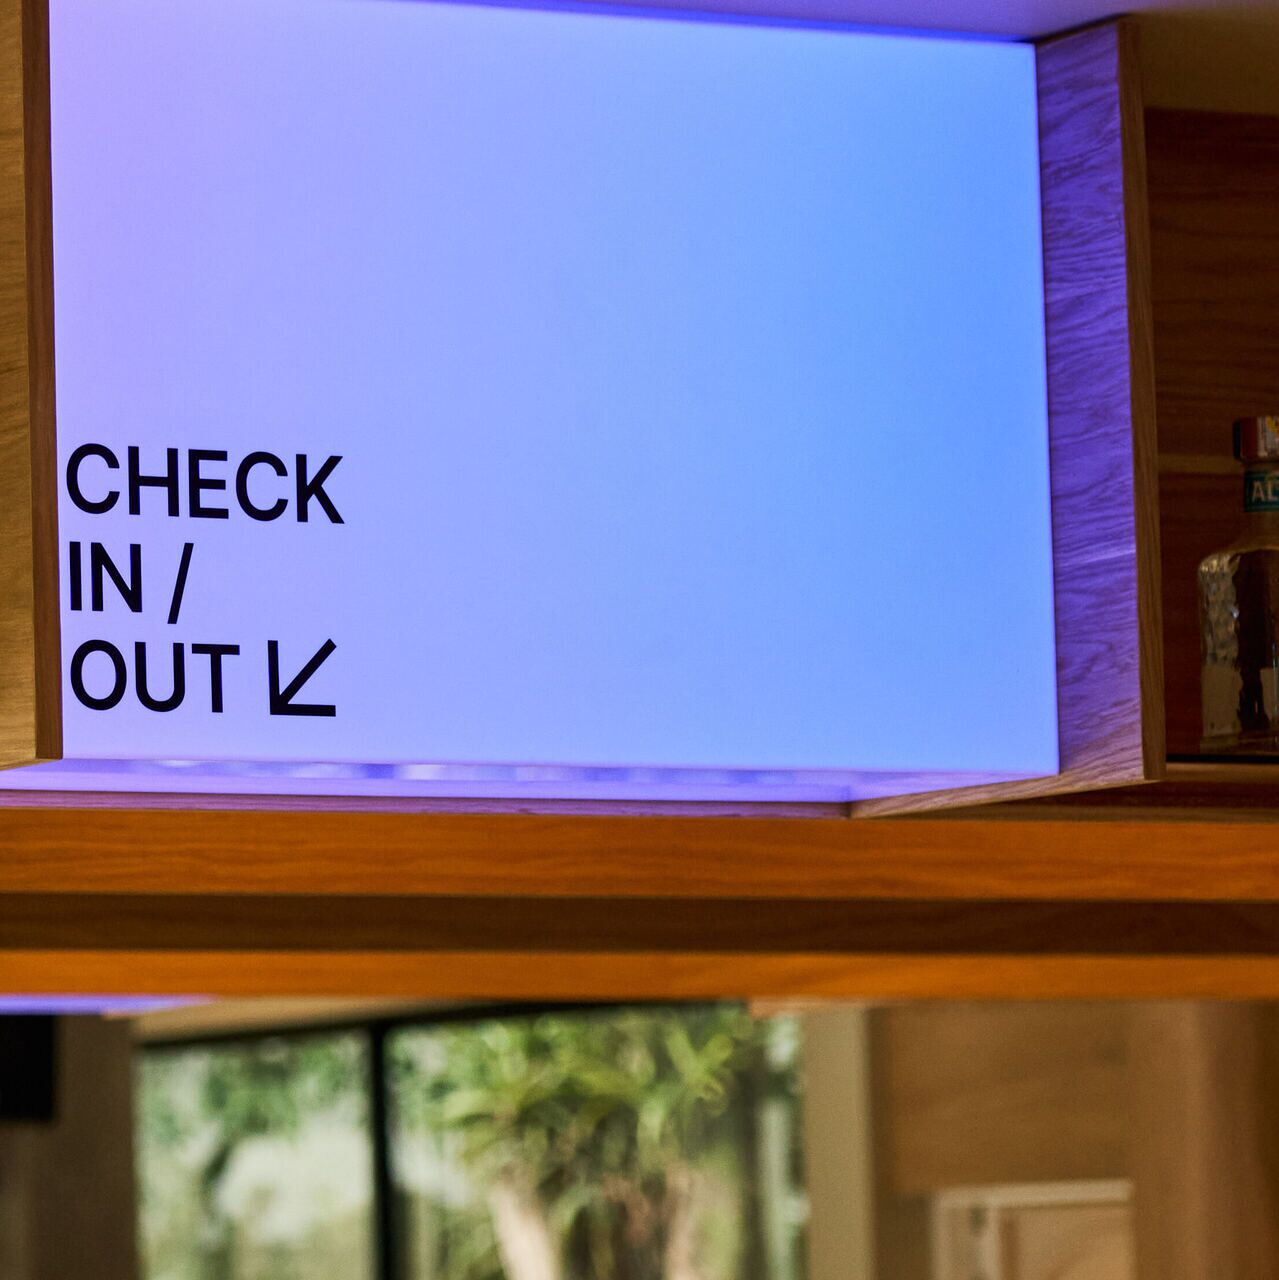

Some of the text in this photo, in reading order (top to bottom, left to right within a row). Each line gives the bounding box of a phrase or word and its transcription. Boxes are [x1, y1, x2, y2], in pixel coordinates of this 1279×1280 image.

[66, 443, 345, 524] CHECK
[69, 541, 194, 624] IN /
[70, 639, 240, 713] OUT
